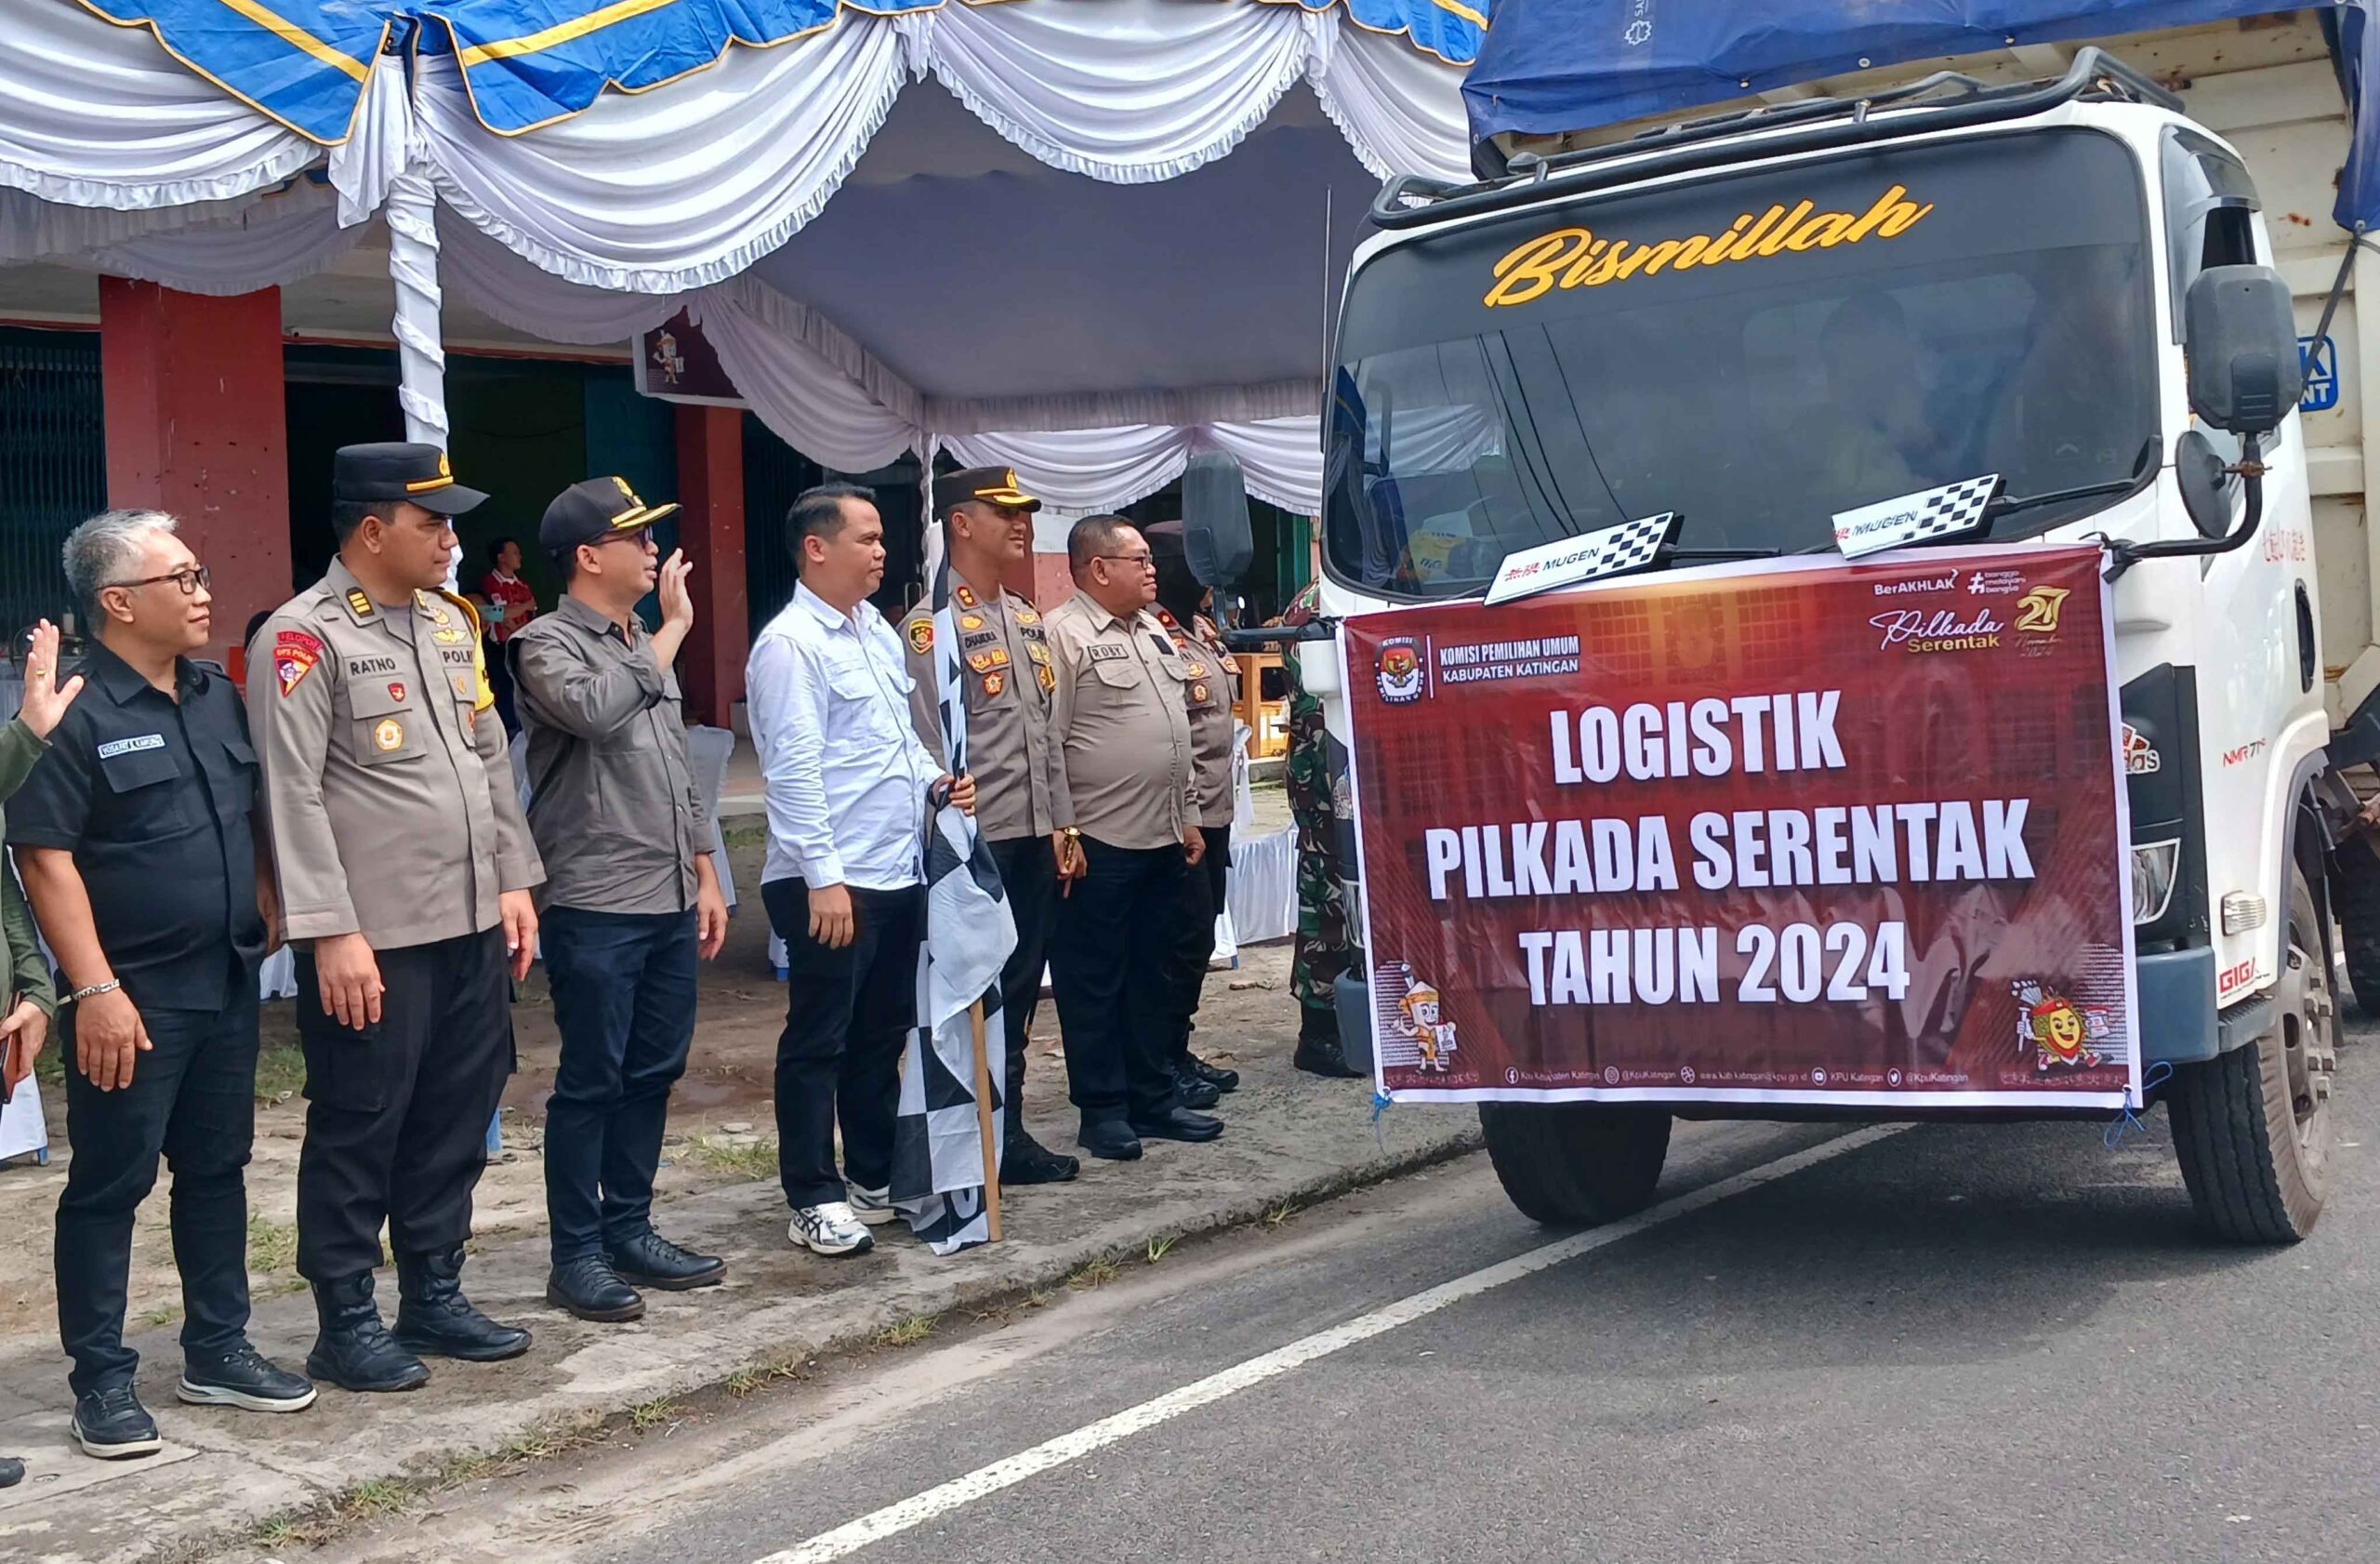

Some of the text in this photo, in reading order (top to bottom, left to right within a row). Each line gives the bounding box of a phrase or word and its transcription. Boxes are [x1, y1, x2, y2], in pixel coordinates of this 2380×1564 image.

[1634, 0, 1645, 17] SA
[1483, 184, 1934, 308] Bismillah
[2300, 382, 2331, 405] NT
[1852, 510, 1919, 536] MUGEN
[1542, 547, 1600, 571] MUGEN
[1874, 577, 1955, 596] BerAKHLAK
[1870, 608, 2004, 651] Pilkada
[1440, 635, 1580, 667] KOMISI PEMILIHAN UMUM
[1907, 634, 2001, 653] Serentak
[1443, 659, 1579, 683] KABUPATEN KATINGAN
[1550, 690, 1846, 784] LOGISTIK
[1425, 799, 2035, 900] PILKADA SERENTAK
[1518, 921, 1911, 1005] TAHUN 2024
